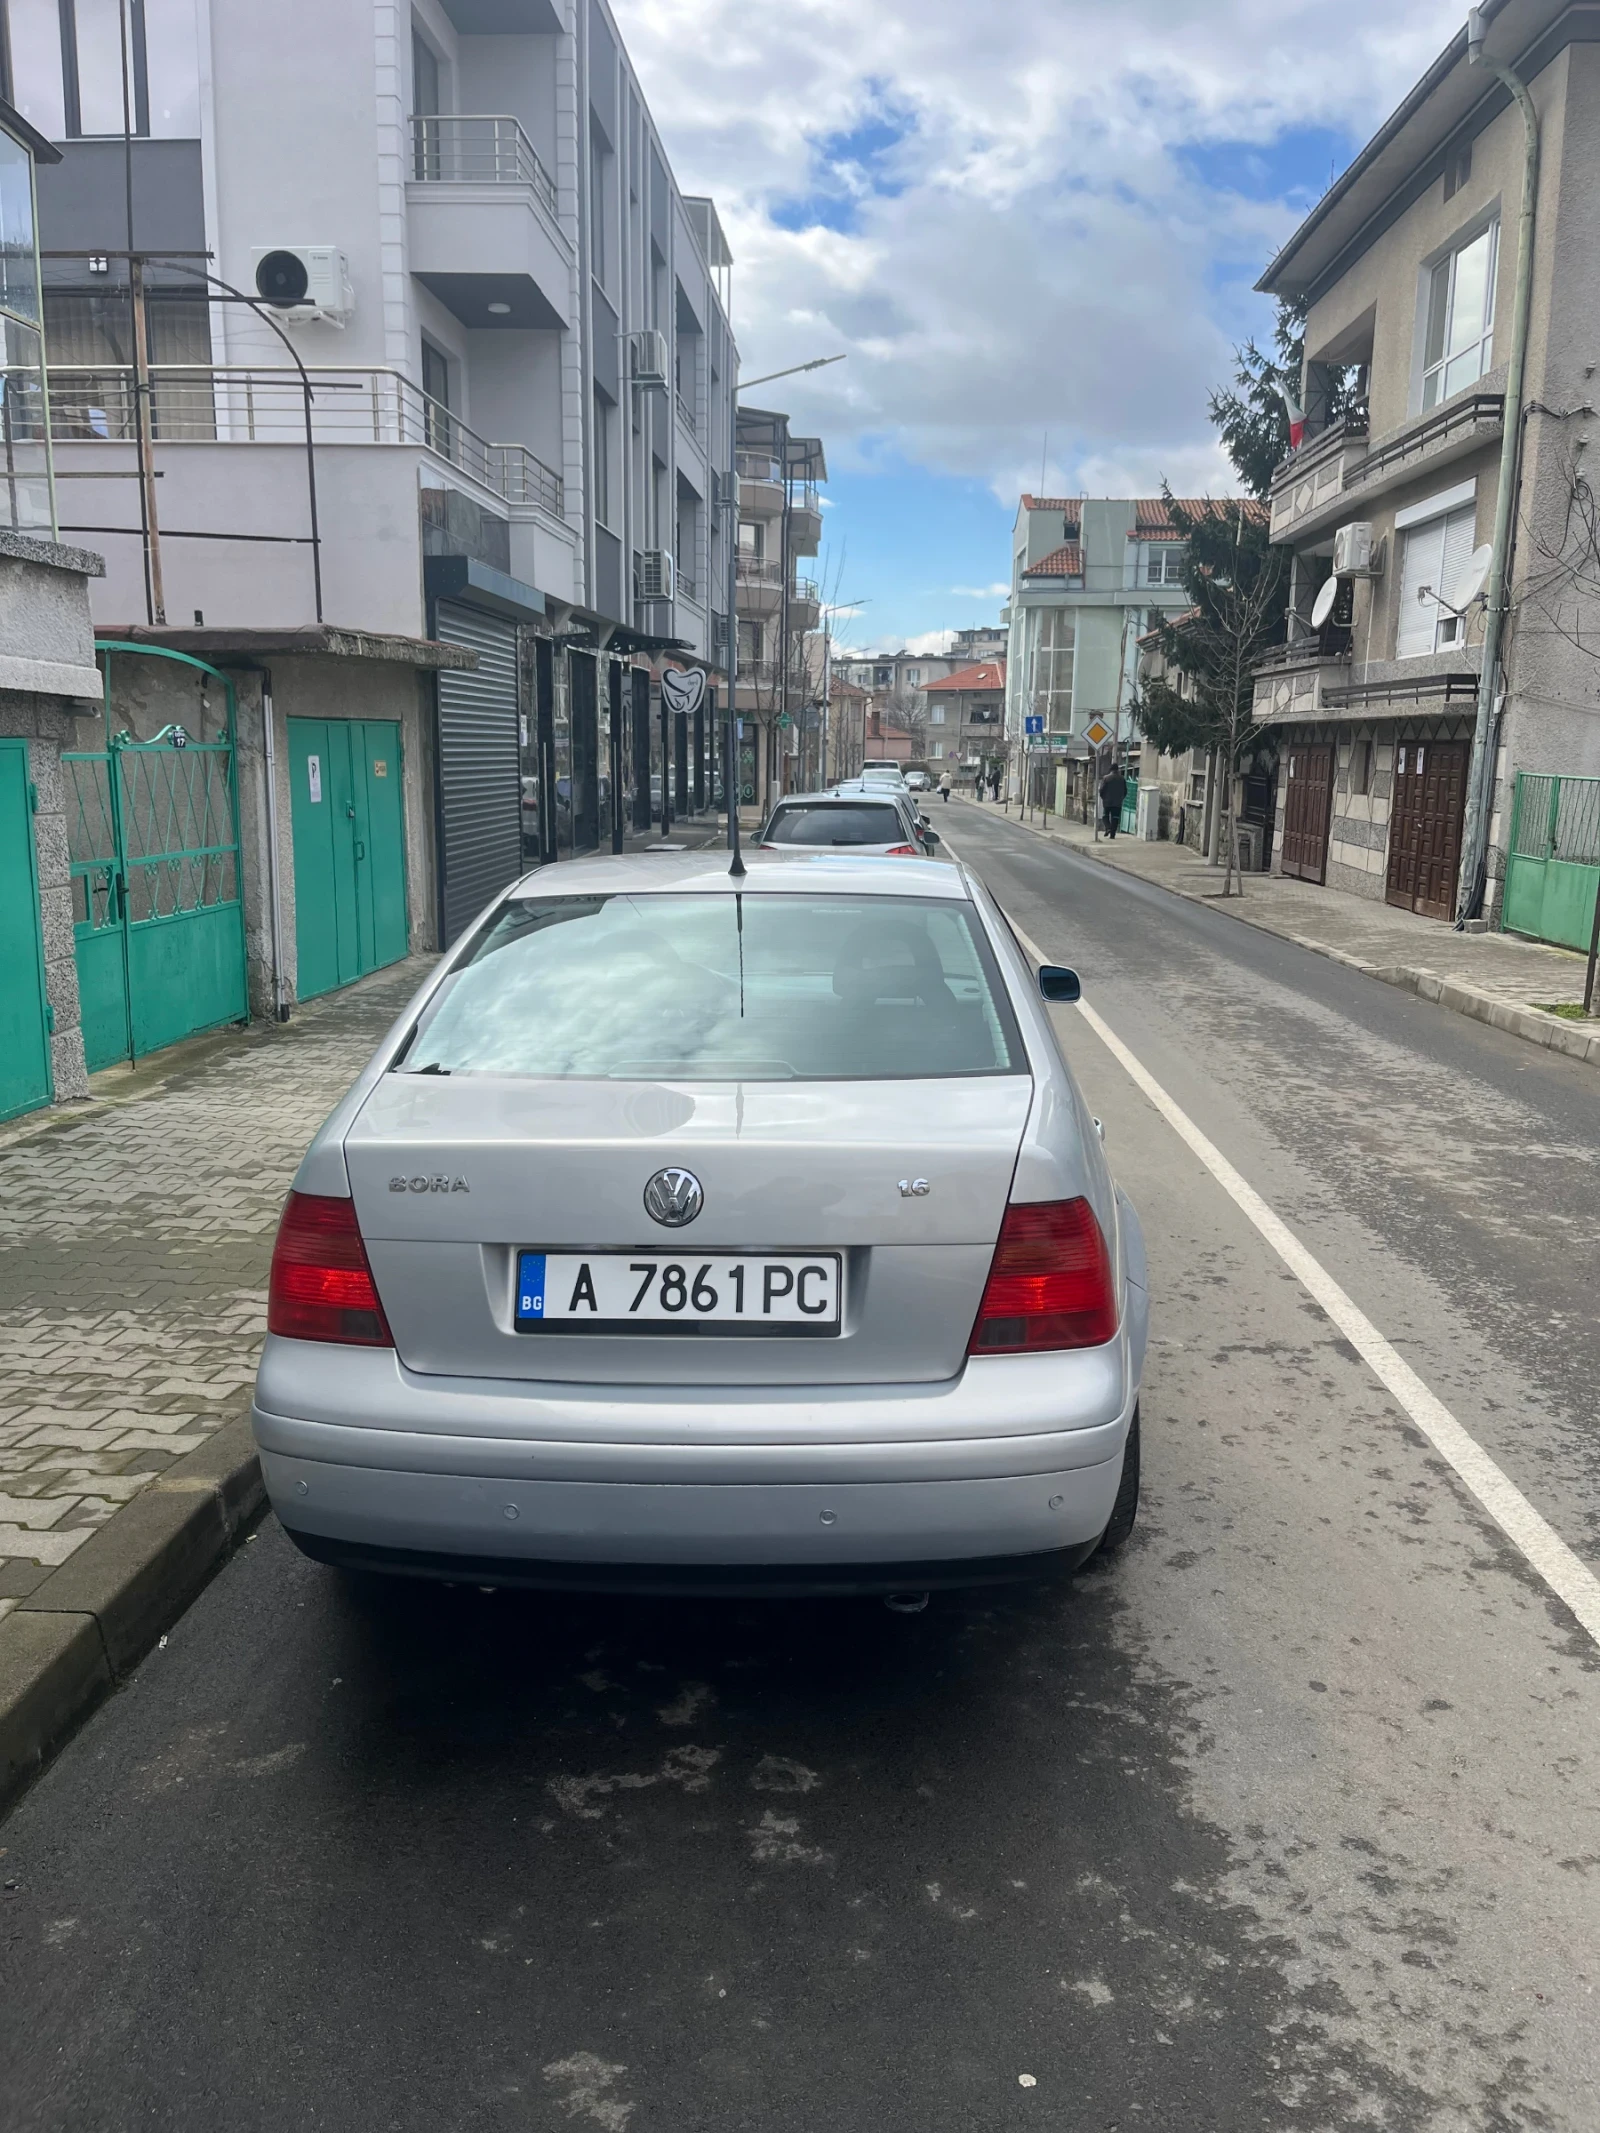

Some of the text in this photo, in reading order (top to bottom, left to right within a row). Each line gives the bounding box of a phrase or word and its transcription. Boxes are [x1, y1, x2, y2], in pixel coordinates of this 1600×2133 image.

[177, 737, 185, 747] 17
[388, 1175, 471, 1193] BORA
[521, 1295, 542, 1311] BG
